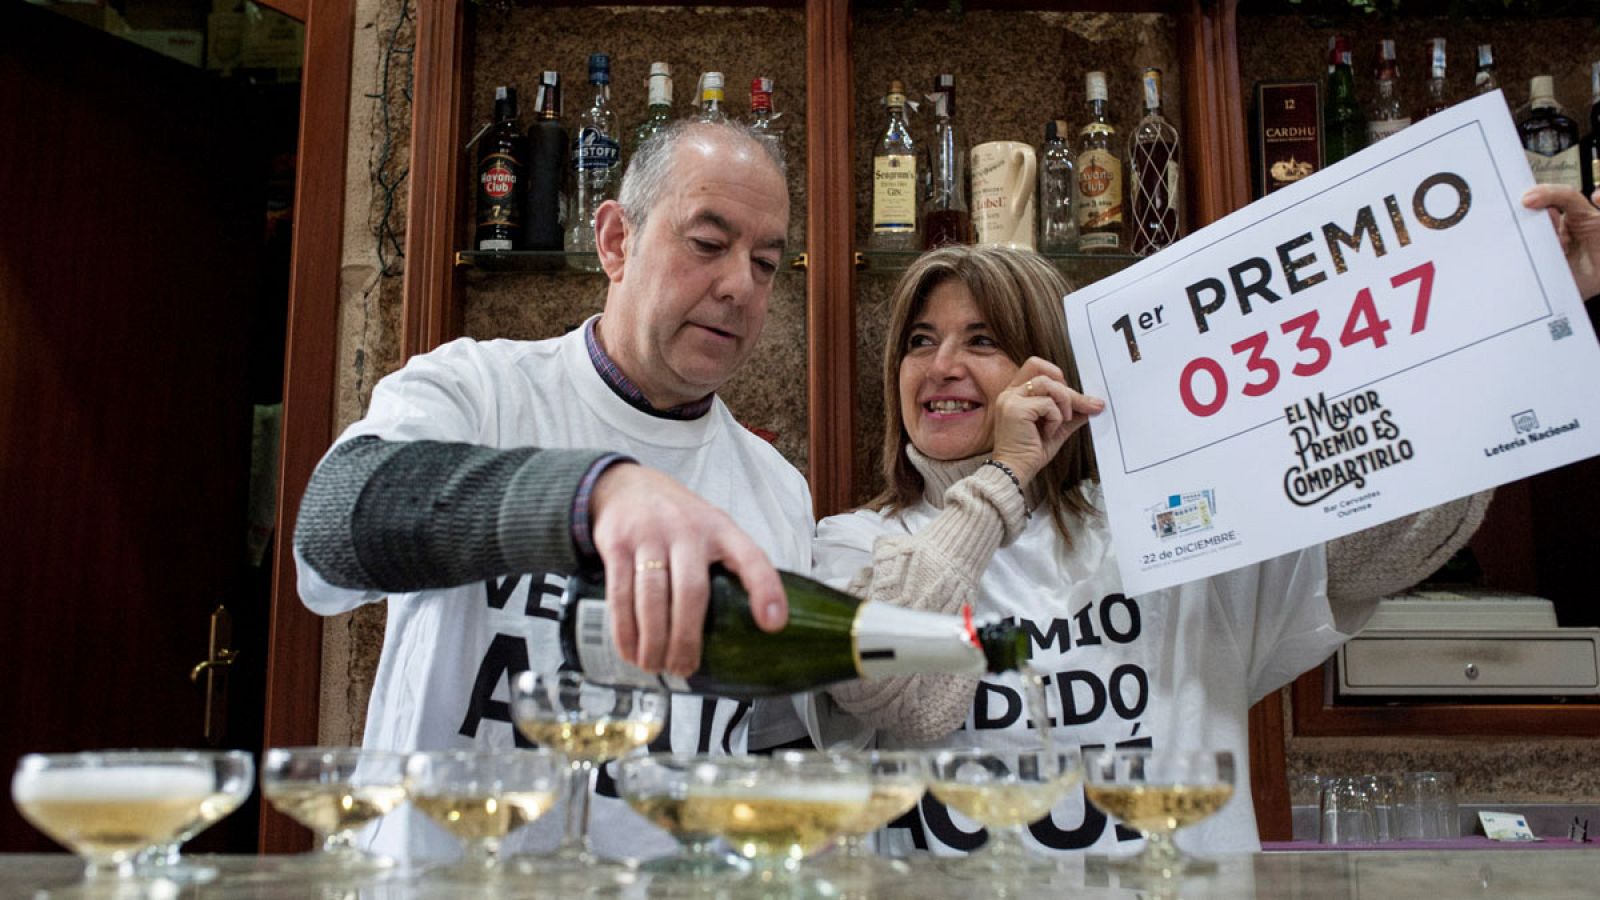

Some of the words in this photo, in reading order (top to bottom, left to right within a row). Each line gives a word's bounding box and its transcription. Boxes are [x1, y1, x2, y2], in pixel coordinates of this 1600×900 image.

[1285, 99, 1296, 110] 12
[1266, 127, 1316, 137] CARDHU
[487, 182, 509, 192] Club
[492, 205, 501, 217] 7
[1111, 302, 1165, 363] 1er
[1185, 171, 1472, 335] PREMIO
[1179, 260, 1436, 418] 03347
[1284, 403, 1307, 425] EL
[1304, 391, 1382, 437] MAYOR
[1528, 418, 1581, 443] Nacional
[1289, 426, 1369, 470] PREMIO
[1371, 409, 1400, 441] ES
[1283, 439, 1414, 507] COMPARTIRLO
[1142, 552, 1157, 565] 22
[1158, 549, 1173, 560] de
[1174, 529, 1237, 556] DICIEMBRE
